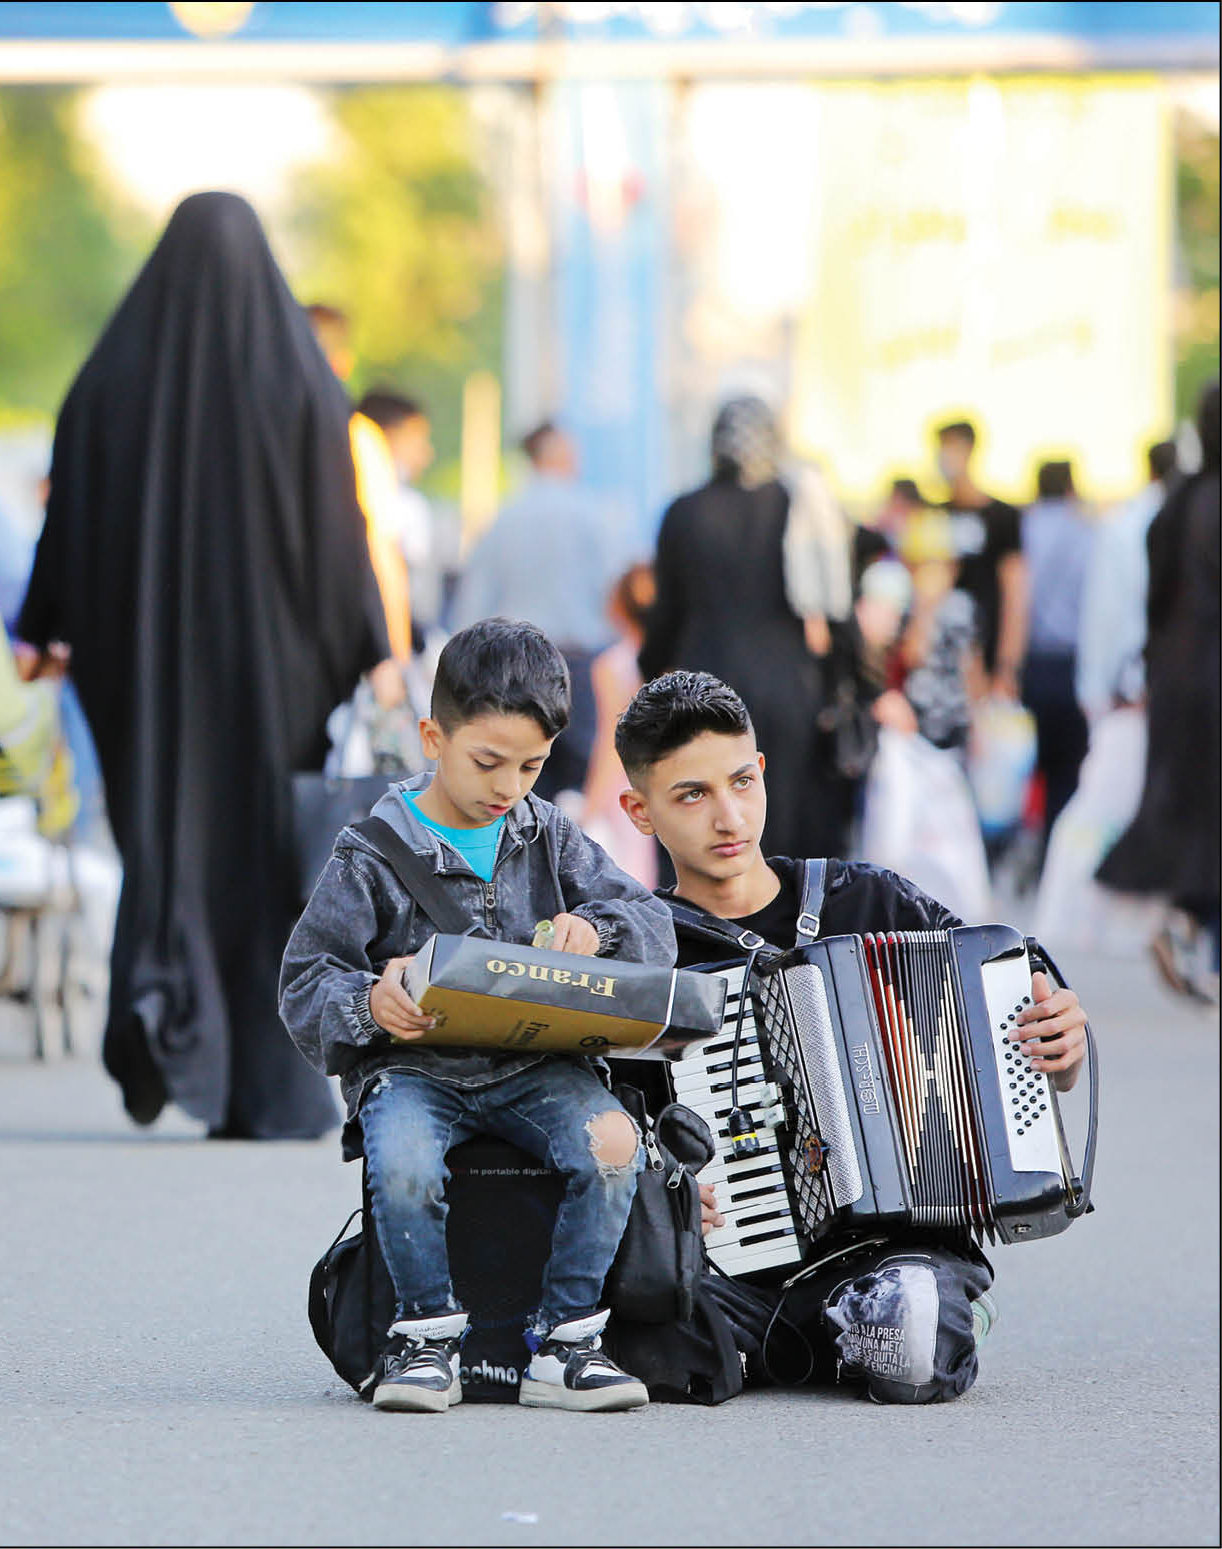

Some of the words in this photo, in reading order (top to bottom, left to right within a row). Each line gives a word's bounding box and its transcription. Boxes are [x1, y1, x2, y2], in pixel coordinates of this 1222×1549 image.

[486, 959, 618, 998] Franco
[481, 1168, 520, 1176] portable
[866, 1325, 876, 1339] LA
[877, 1326, 905, 1343] PRESA
[880, 1340, 905, 1354] META
[874, 1351, 899, 1366] QUITA
[899, 1355, 911, 1369] LA
[458, 1359, 518, 1385] echno
